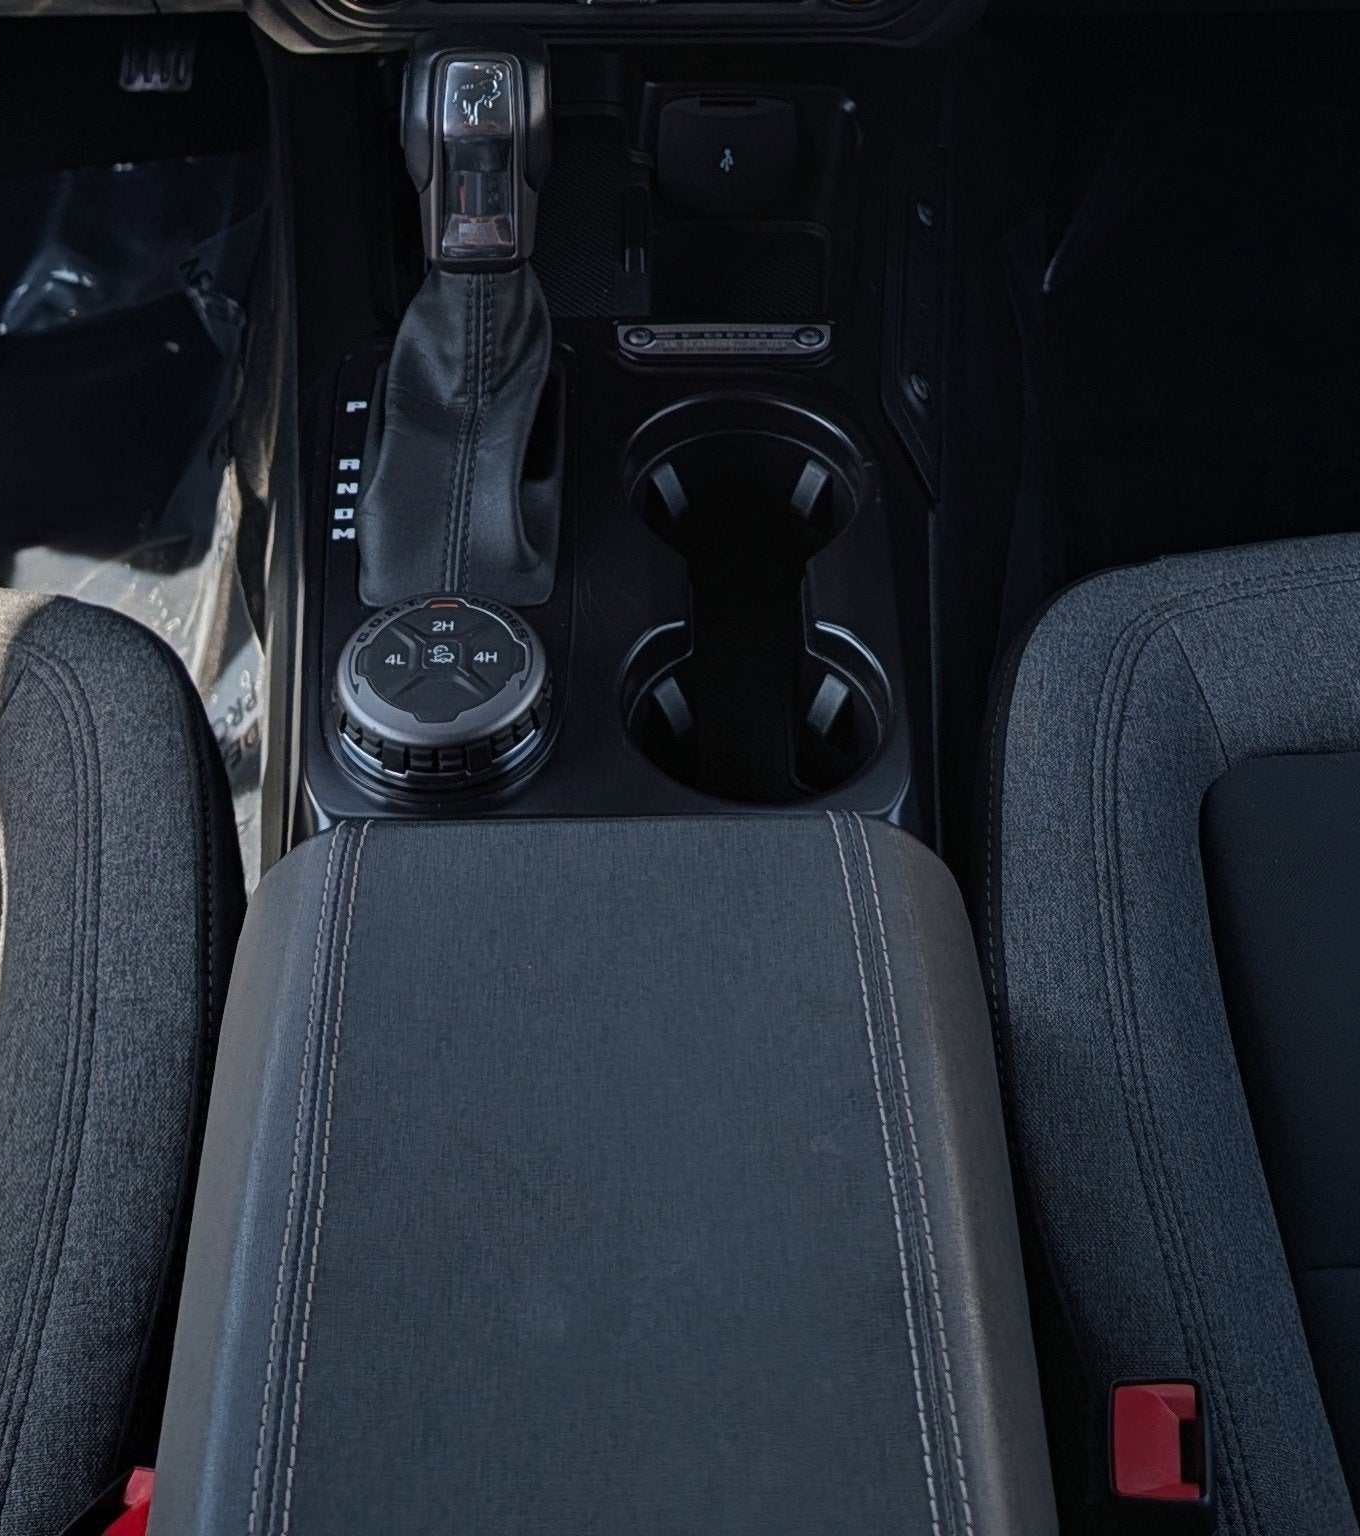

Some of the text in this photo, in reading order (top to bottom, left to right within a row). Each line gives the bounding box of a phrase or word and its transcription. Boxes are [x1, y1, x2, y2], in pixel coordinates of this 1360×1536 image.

[346, 401, 368, 413] P
[339, 459, 360, 470] R
[336, 482, 358, 495] N
[334, 508, 354, 520] D
[332, 527, 356, 540] M
[470, 598, 530, 639] MODES
[432, 620, 455, 632] 2H
[385, 651, 498, 665] 4L 4H
